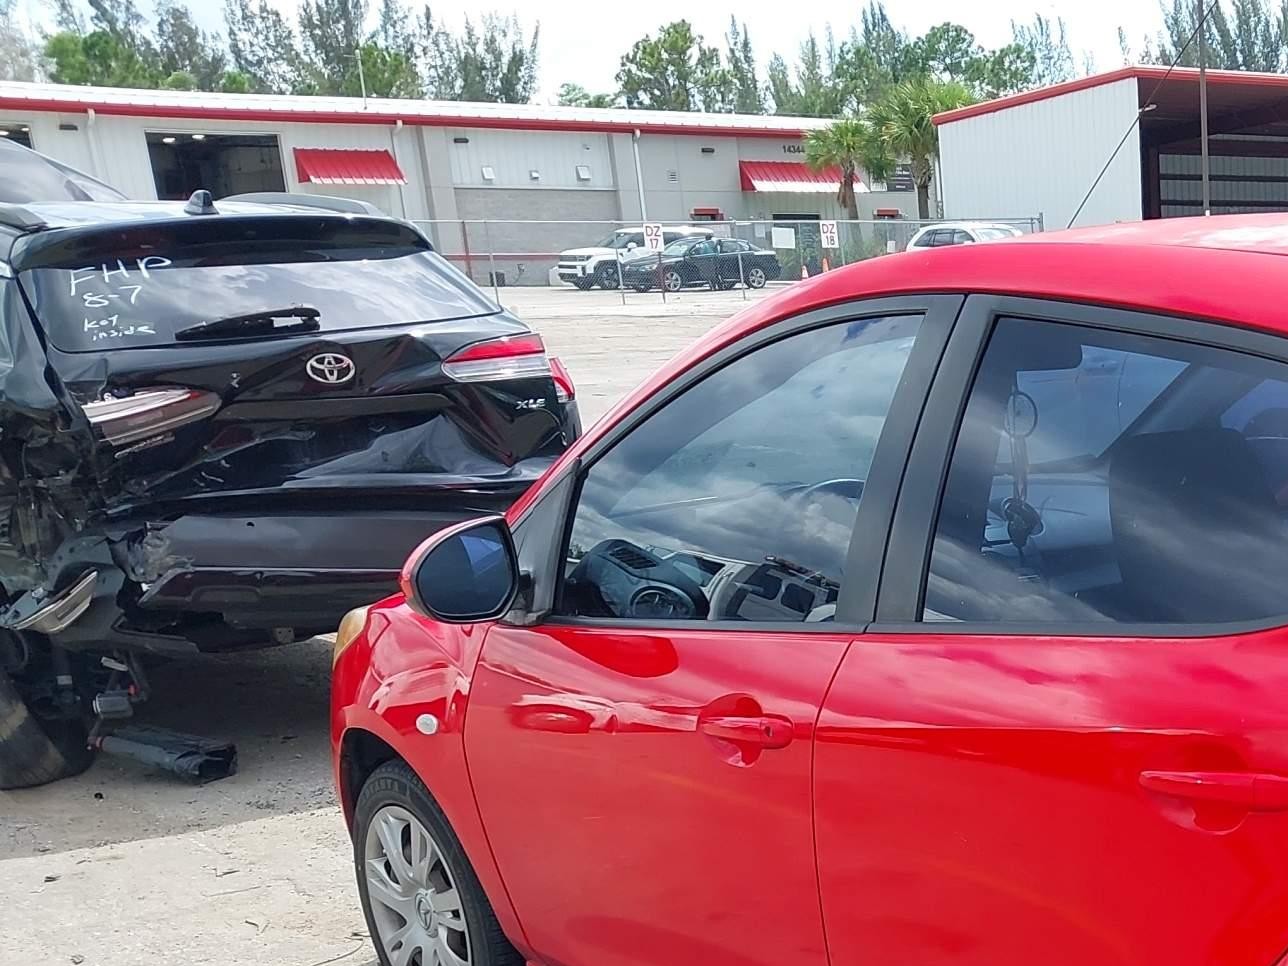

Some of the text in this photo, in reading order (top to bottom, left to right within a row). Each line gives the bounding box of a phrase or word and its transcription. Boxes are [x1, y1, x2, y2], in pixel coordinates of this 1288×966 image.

[645, 225, 661, 236] DZ
[821, 223, 835, 234] DZ
[650, 238, 659, 249] 17
[826, 235, 835, 246] 18
[71, 256, 172, 296] FHP
[83, 285, 142, 307] 8-7
[515, 398, 546, 409] XLE
